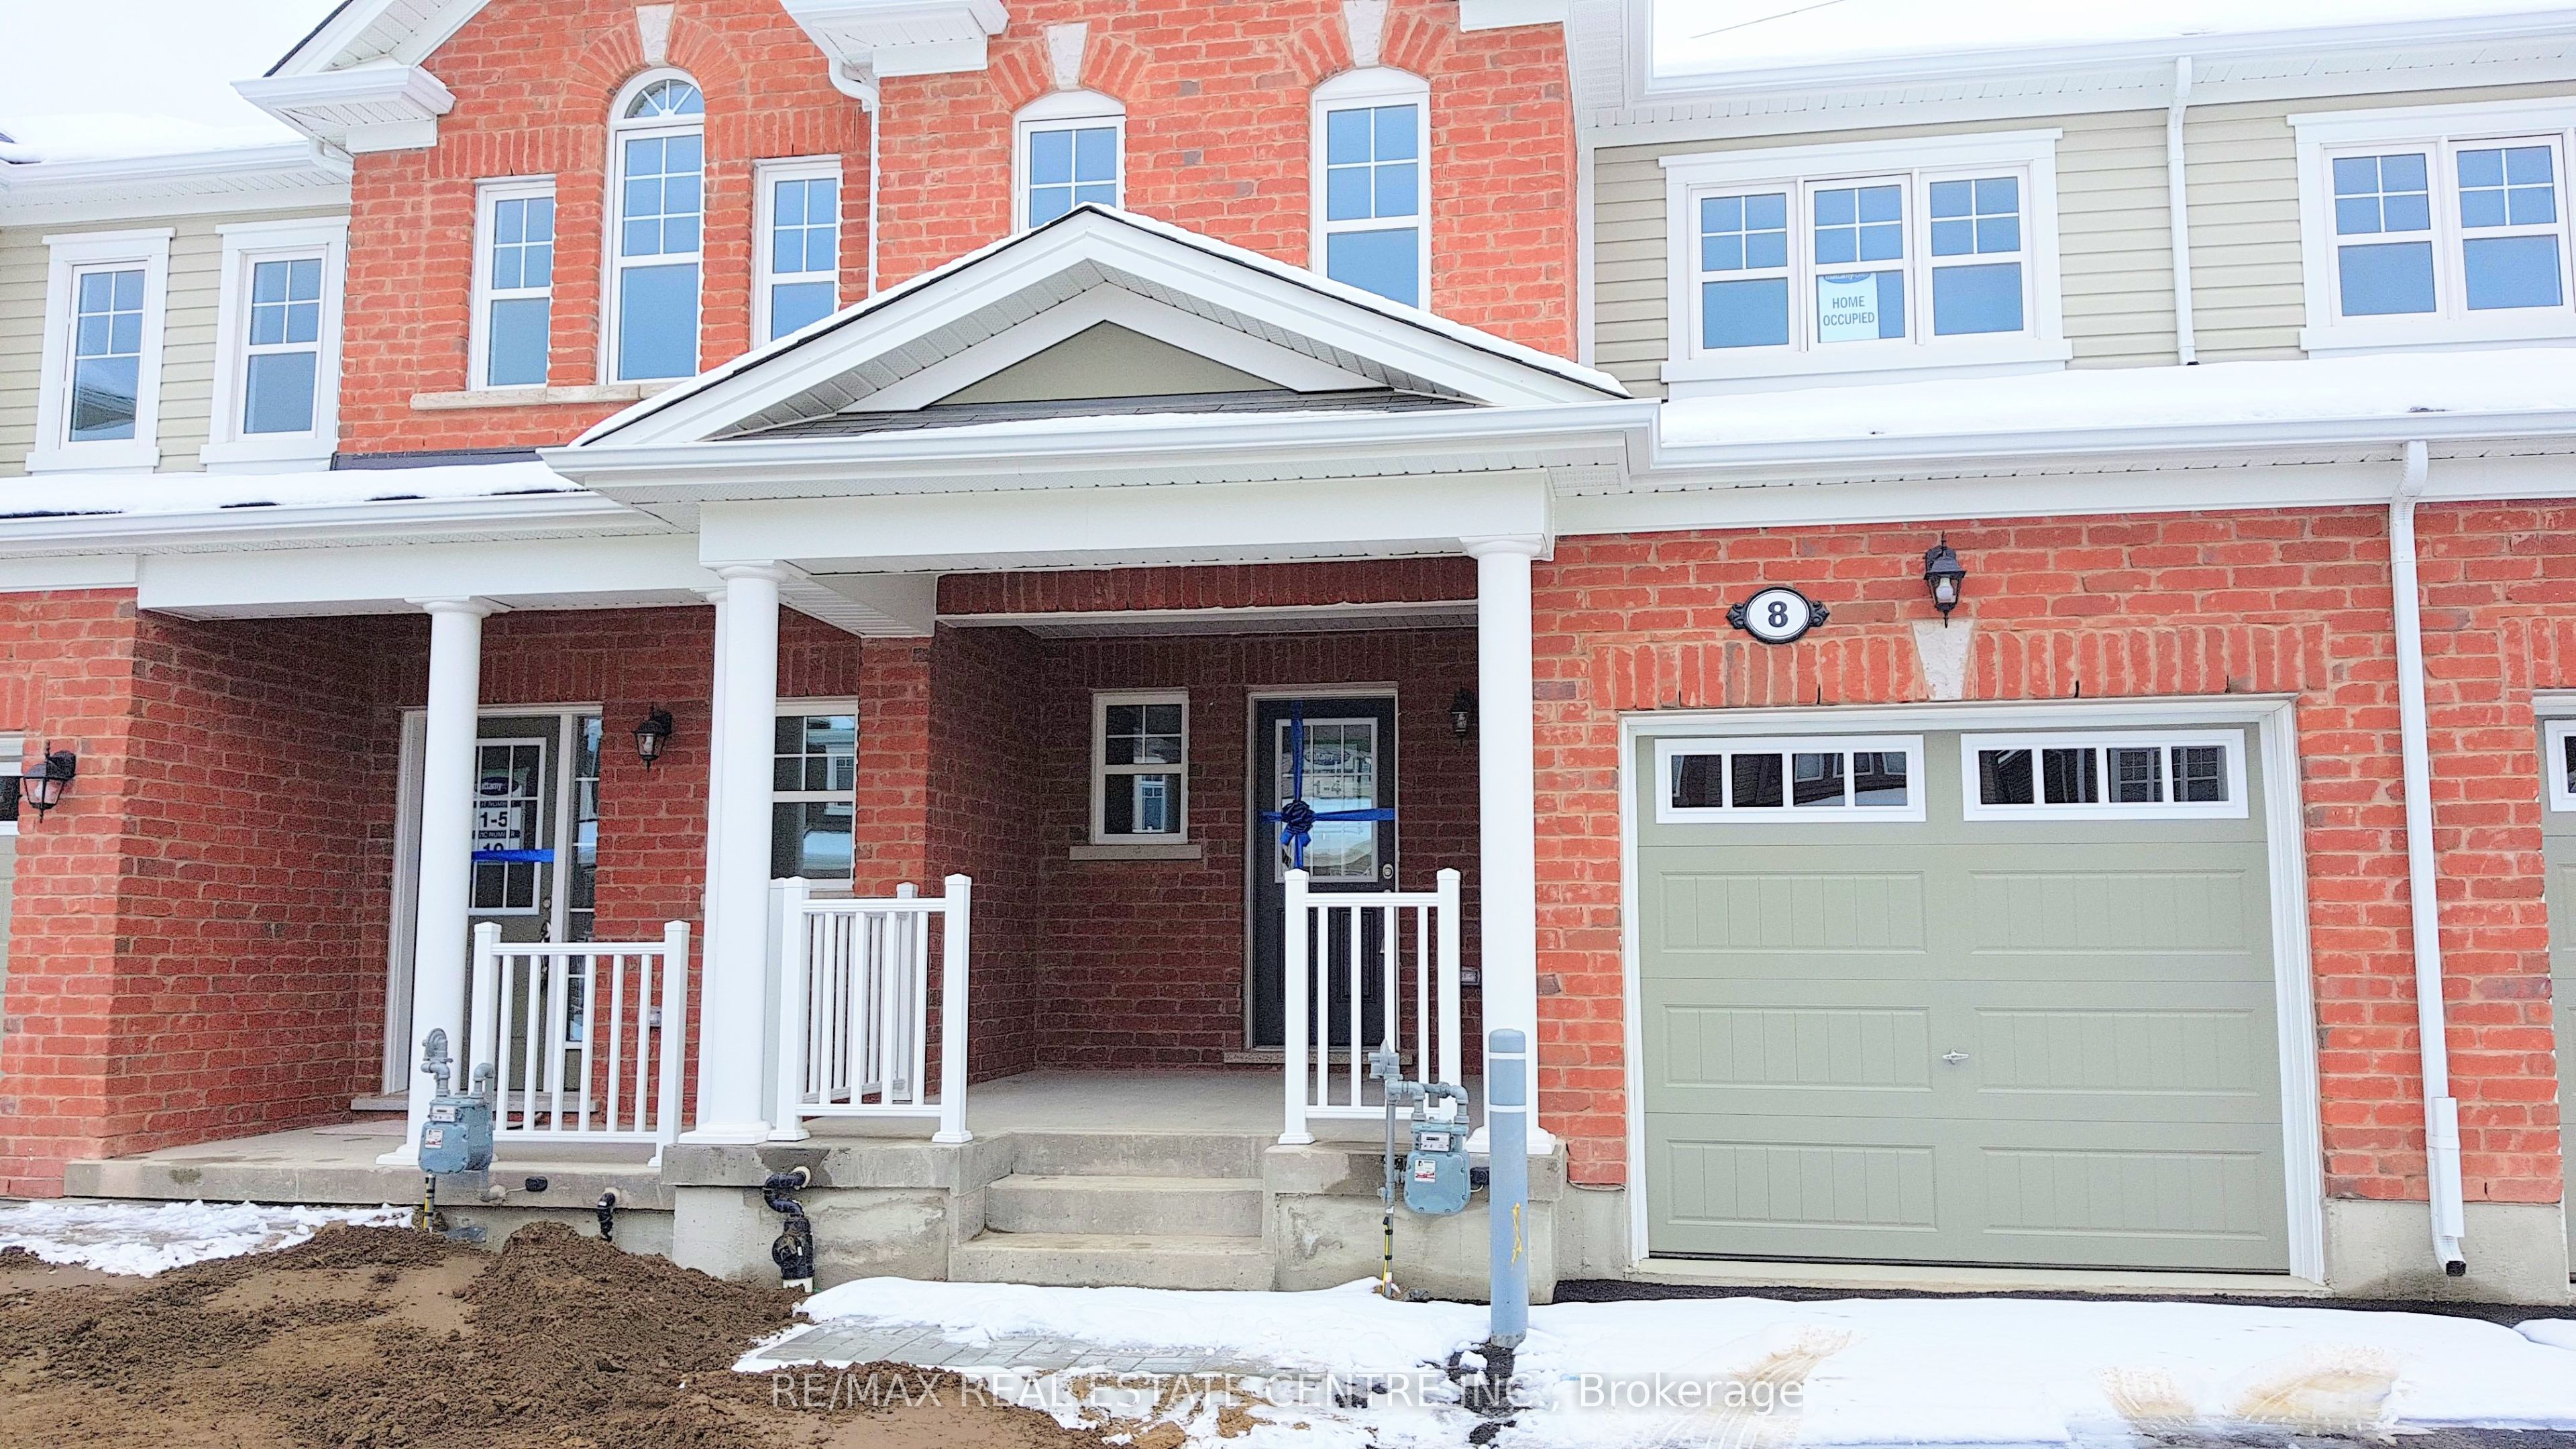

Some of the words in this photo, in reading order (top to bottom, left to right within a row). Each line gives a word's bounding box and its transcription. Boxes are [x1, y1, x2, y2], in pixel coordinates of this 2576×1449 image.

[1832, 296, 1866, 309] HOME
[1823, 312, 1875, 326] OCCUPIED
[1768, 600, 1788, 628] 8
